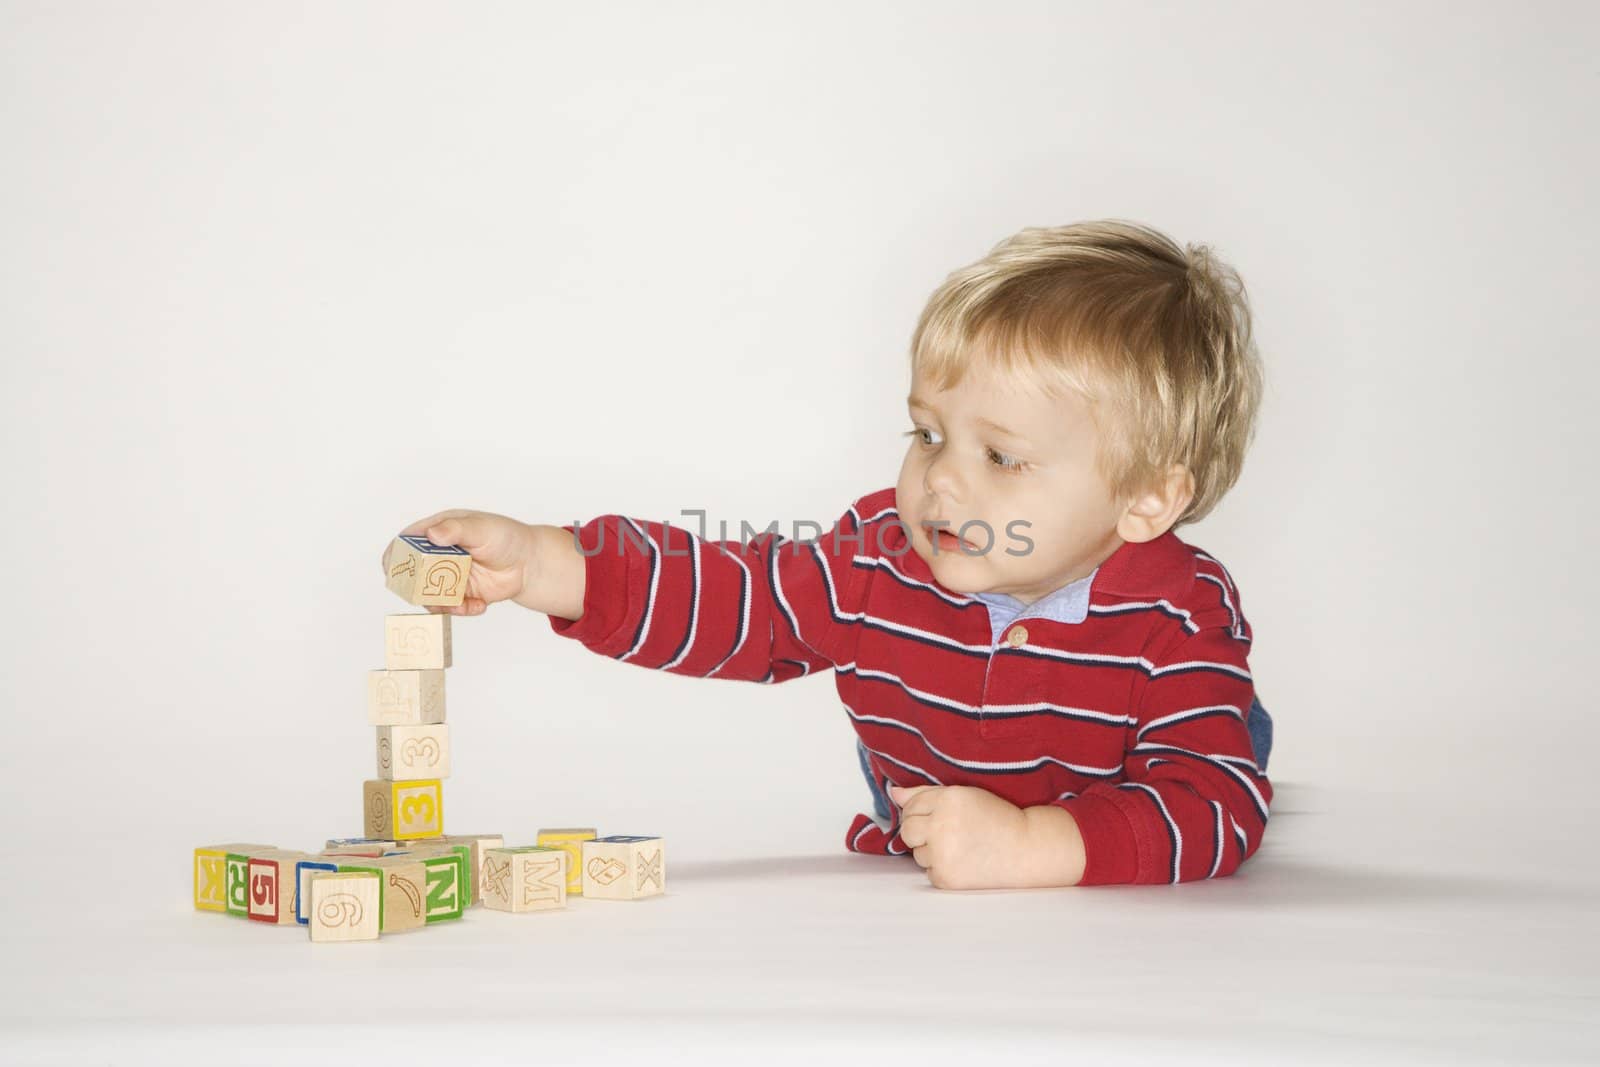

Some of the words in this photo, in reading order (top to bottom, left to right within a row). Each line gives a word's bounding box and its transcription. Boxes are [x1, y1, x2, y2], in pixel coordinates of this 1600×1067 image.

[423, 560, 461, 596] G
[401, 736, 440, 767] 3
[402, 793, 435, 825] 3
[201, 859, 226, 901] K
[523, 857, 561, 905] M
[637, 848, 661, 891] X
[252, 874, 274, 906] 5
